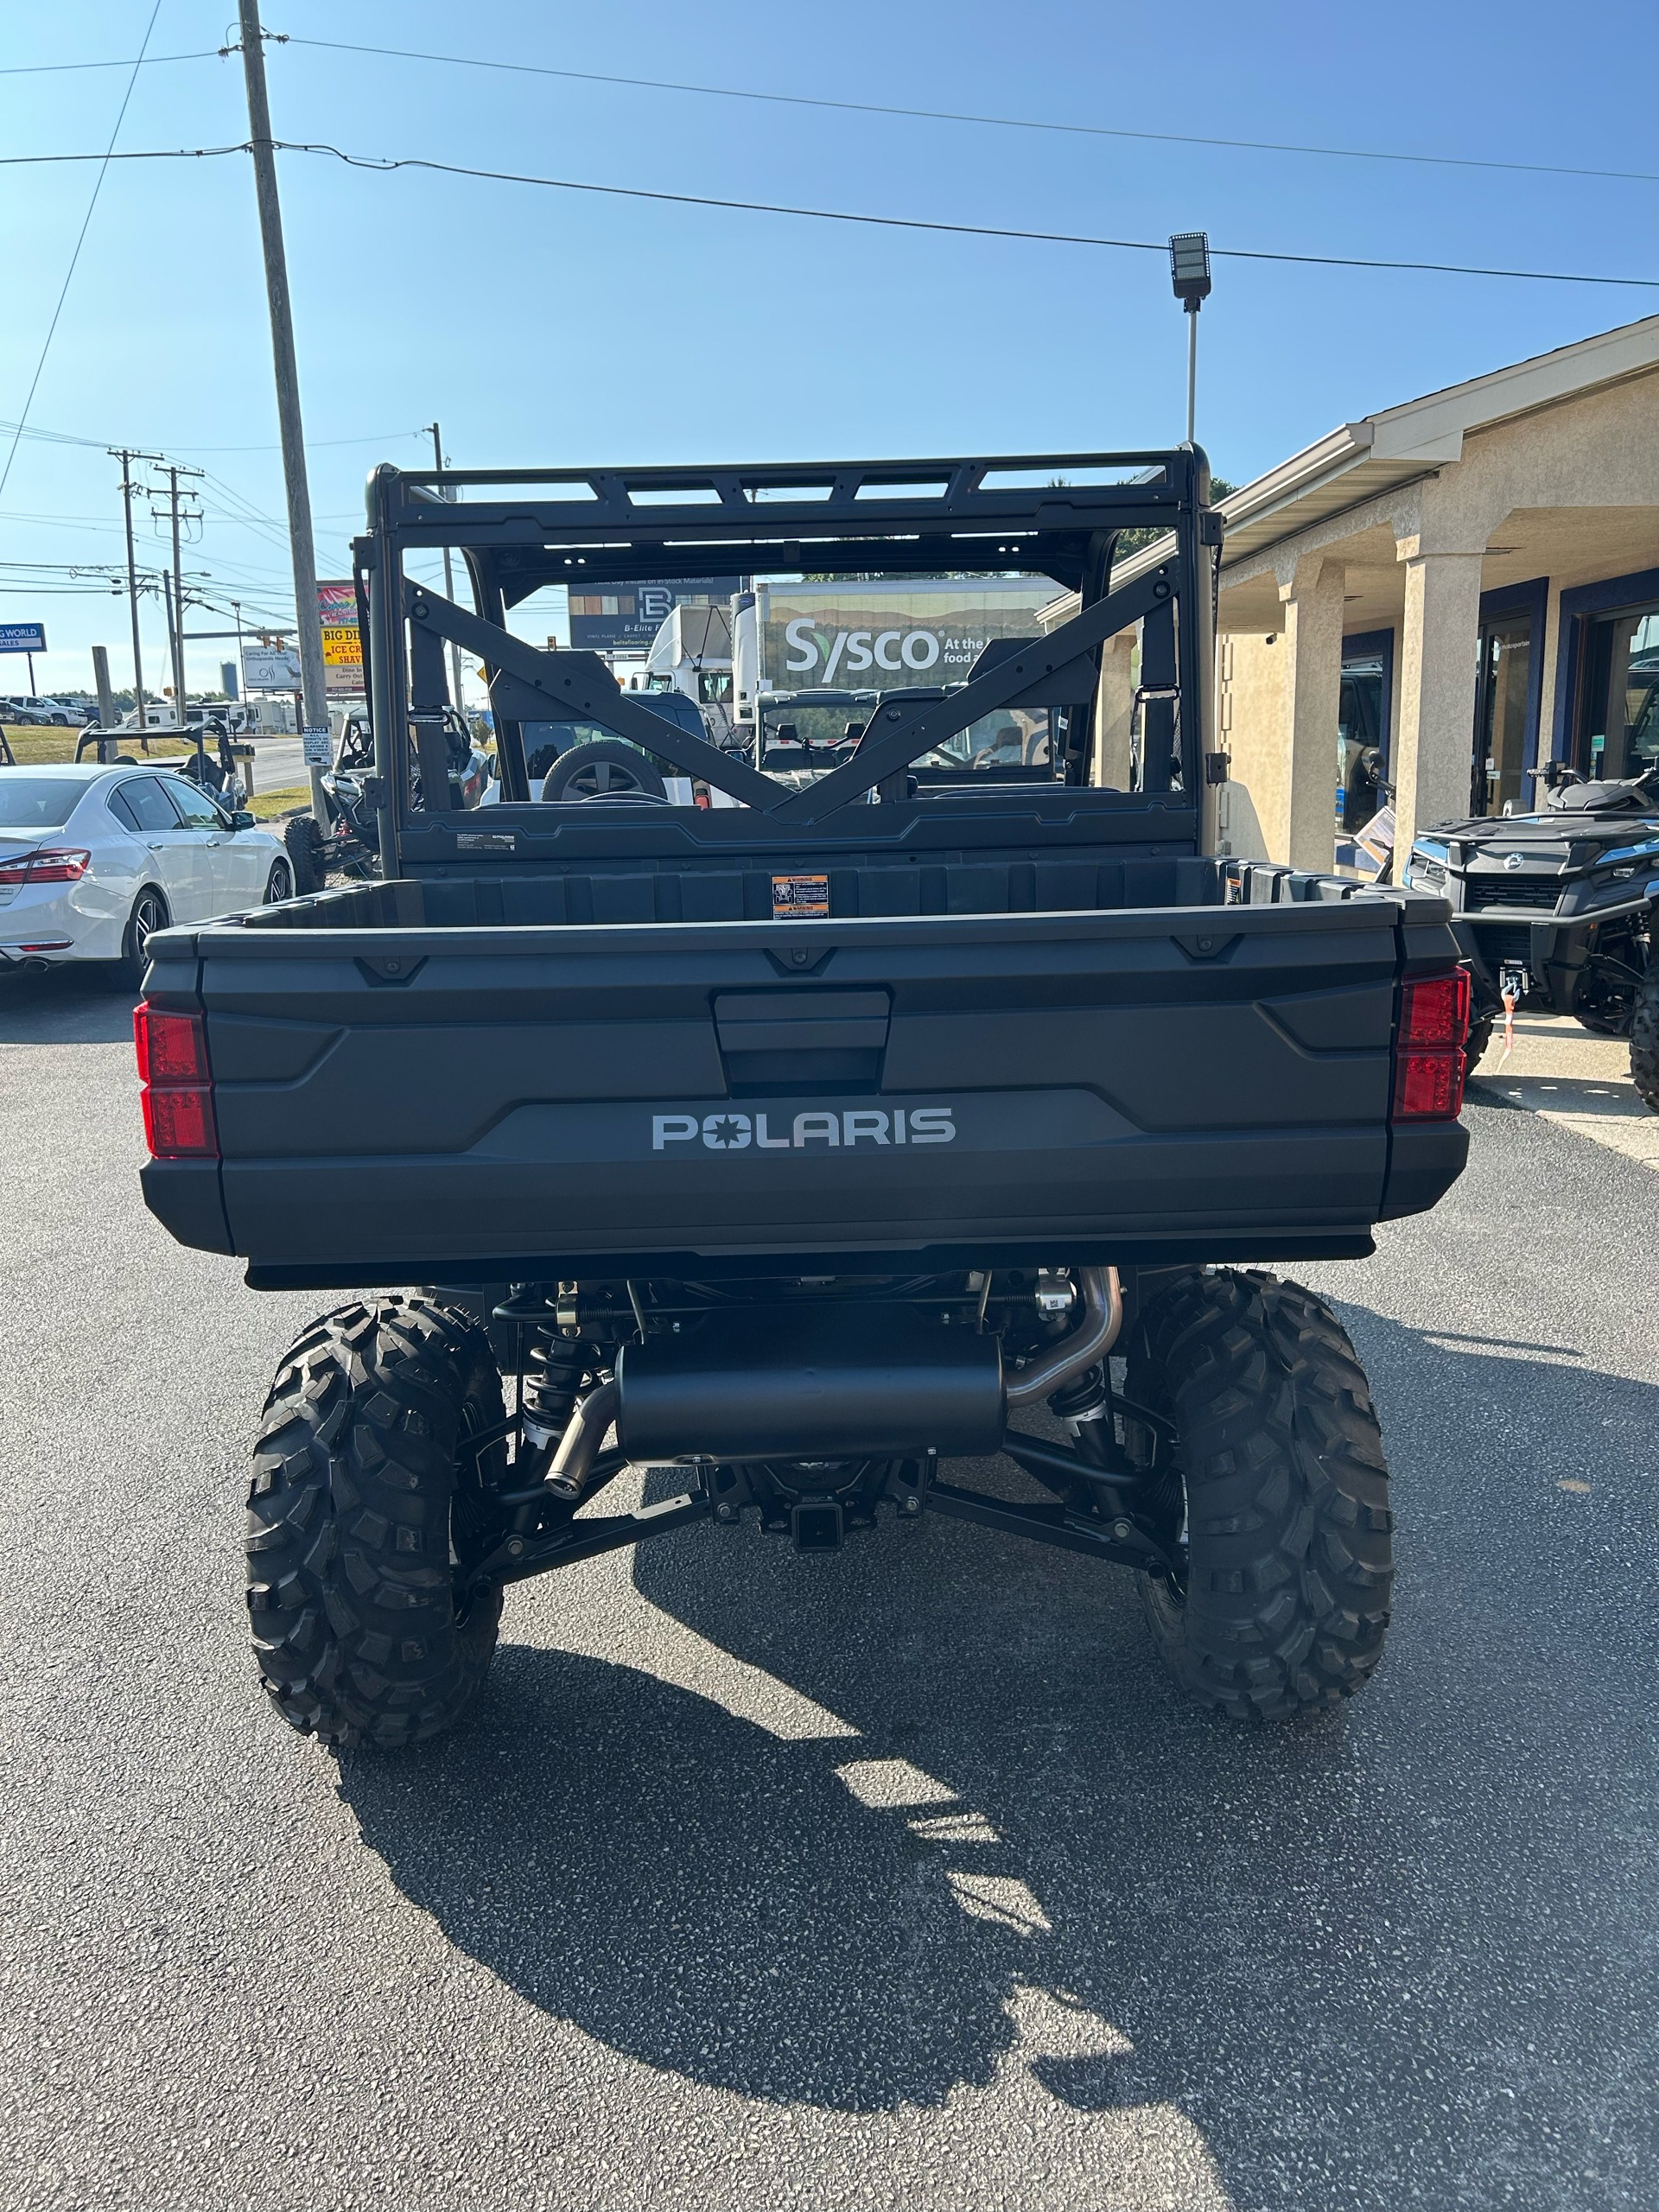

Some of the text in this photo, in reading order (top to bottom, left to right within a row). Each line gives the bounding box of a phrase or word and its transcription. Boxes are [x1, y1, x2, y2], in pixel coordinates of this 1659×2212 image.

[5, 628, 37, 638] WORLD
[323, 630, 343, 641] BIG
[944, 637, 984, 650] At the
[944, 652, 971, 664] food
[652, 1108, 957, 1150] POLARIS
